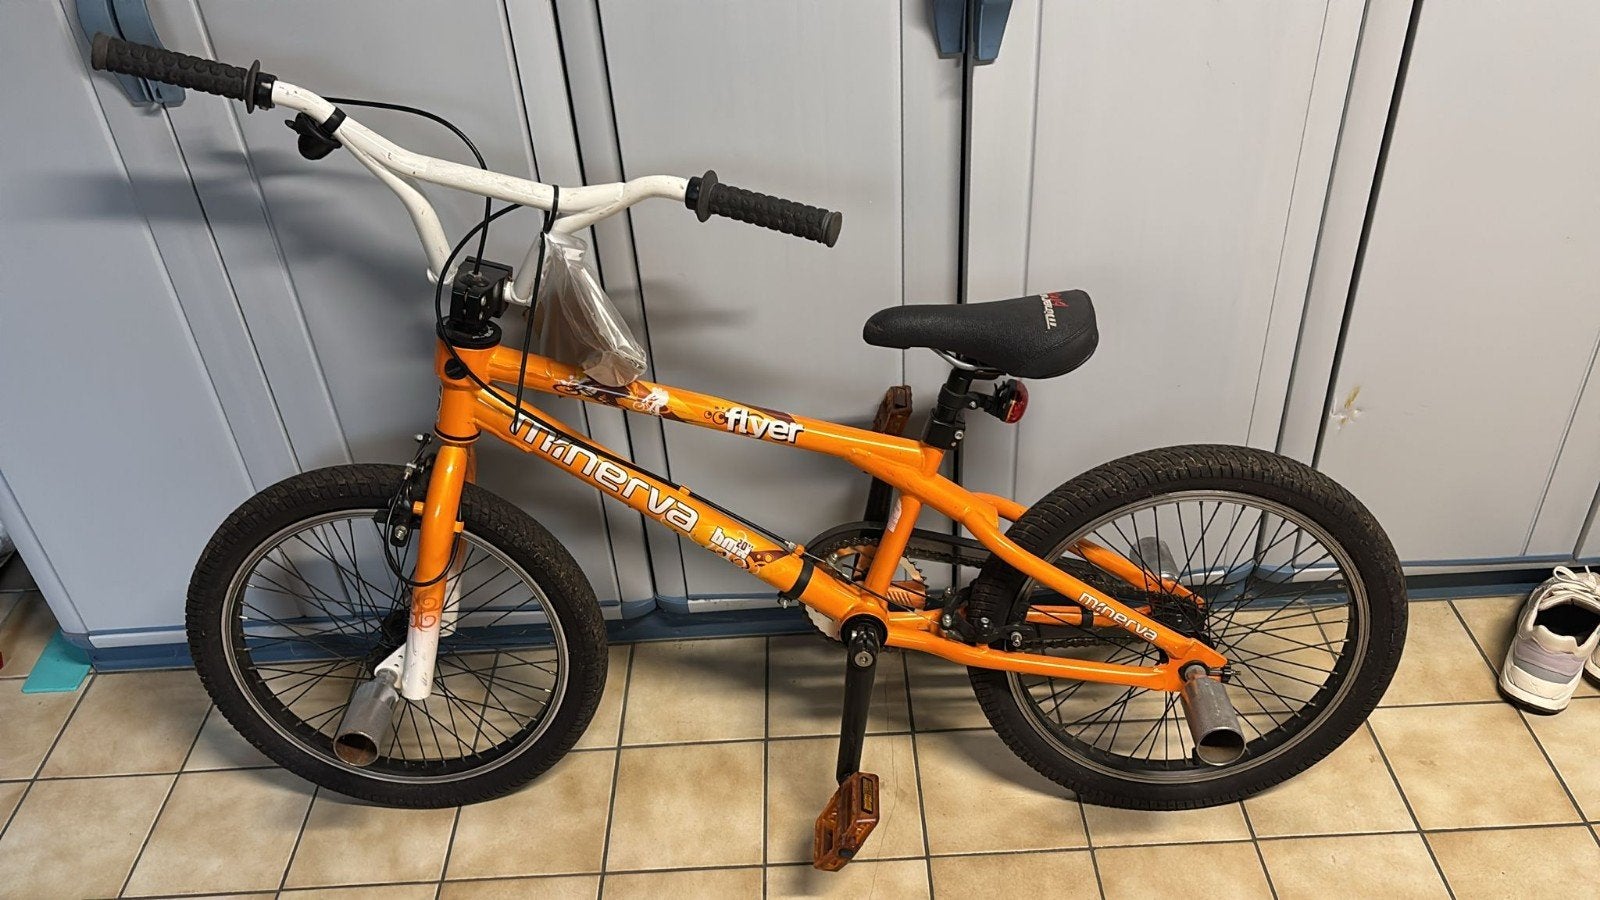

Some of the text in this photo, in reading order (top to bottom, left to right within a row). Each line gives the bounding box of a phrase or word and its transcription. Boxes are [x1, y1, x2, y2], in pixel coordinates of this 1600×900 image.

[723, 406, 805, 444] flyer
[509, 411, 700, 533] minerva
[1078, 592, 1158, 641] minerva
